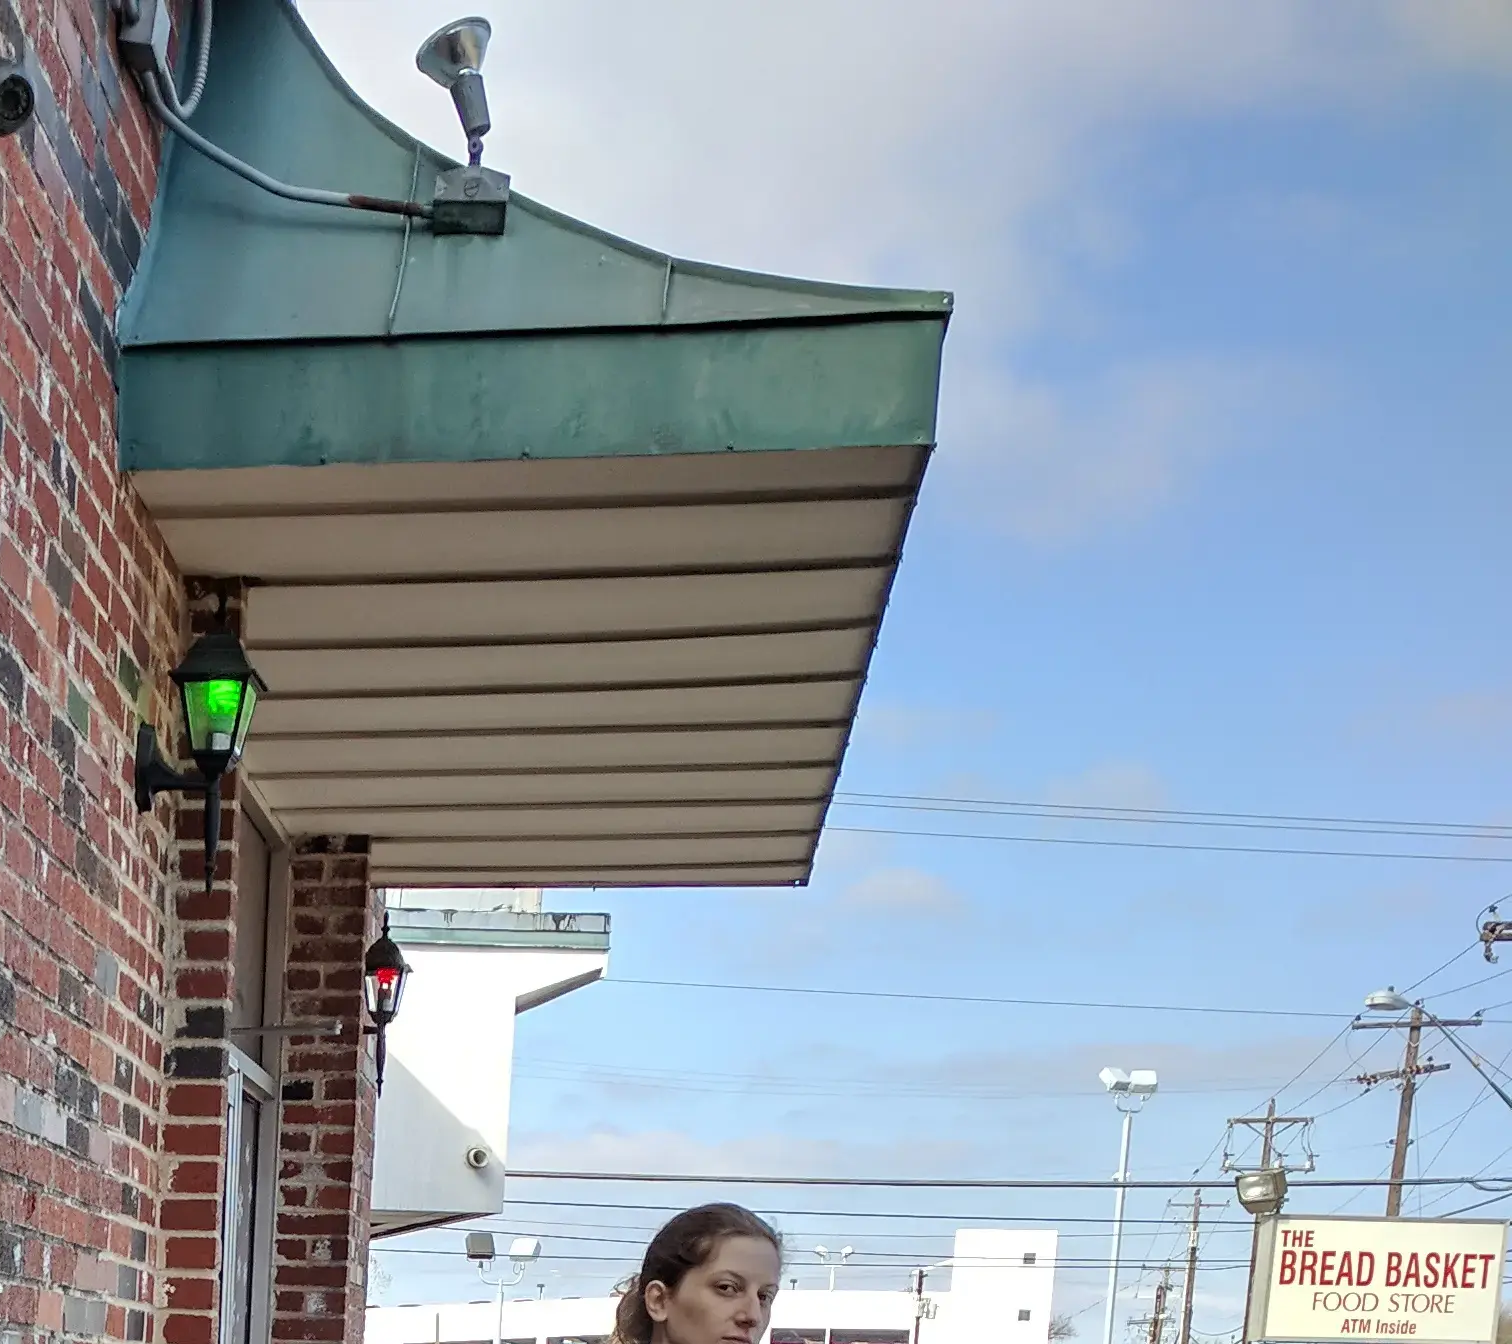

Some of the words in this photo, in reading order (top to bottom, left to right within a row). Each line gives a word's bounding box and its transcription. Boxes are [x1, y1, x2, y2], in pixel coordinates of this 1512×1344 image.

[1281, 1229, 1315, 1248] THE
[1278, 1250, 1376, 1287] BREAD
[1384, 1252, 1496, 1290] BASKET
[1312, 1291, 1379, 1312] FOOD
[1387, 1293, 1456, 1314] STORE
[1340, 1318, 1371, 1334] ATM
[1375, 1318, 1417, 1335] Inside
